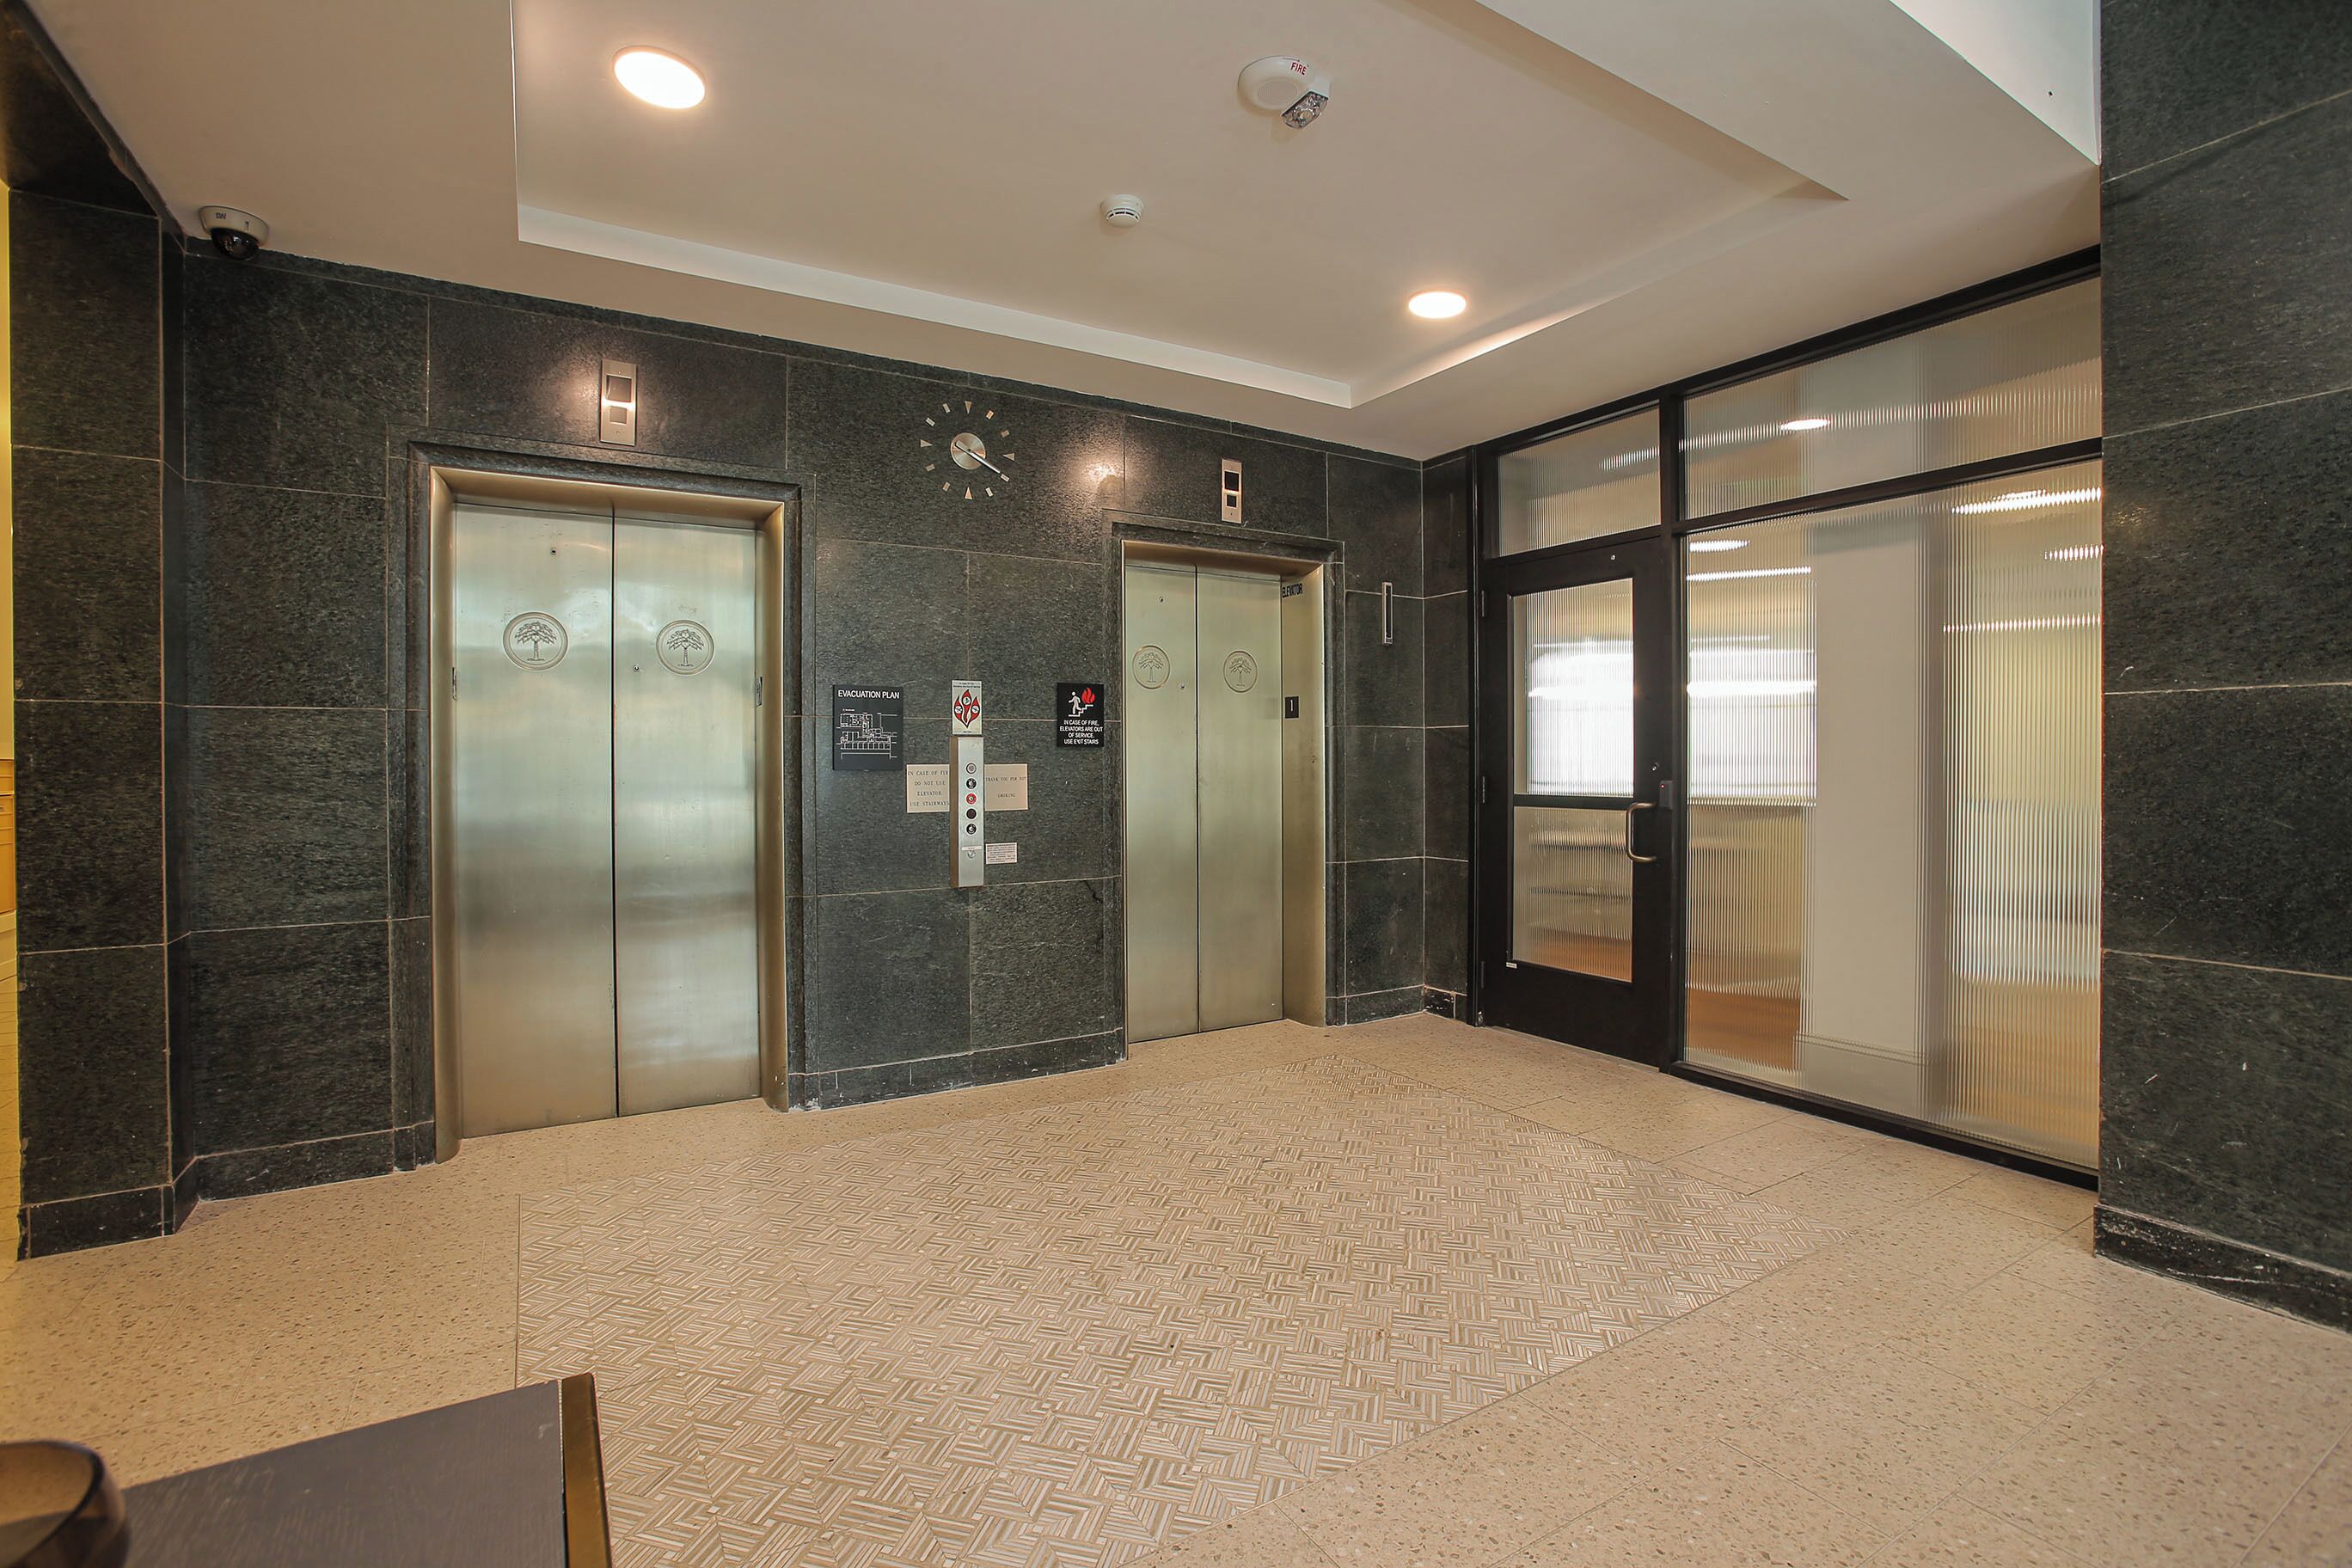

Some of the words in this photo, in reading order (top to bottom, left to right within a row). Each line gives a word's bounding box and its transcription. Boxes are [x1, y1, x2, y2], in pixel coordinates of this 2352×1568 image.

[1290, 62, 1307, 76] FIRE
[1282, 583, 1302, 598] ELEVATOR
[837, 689, 881, 698] EVACUATION
[882, 690, 900, 699] PLAN
[1289, 700, 1293, 712] 1
